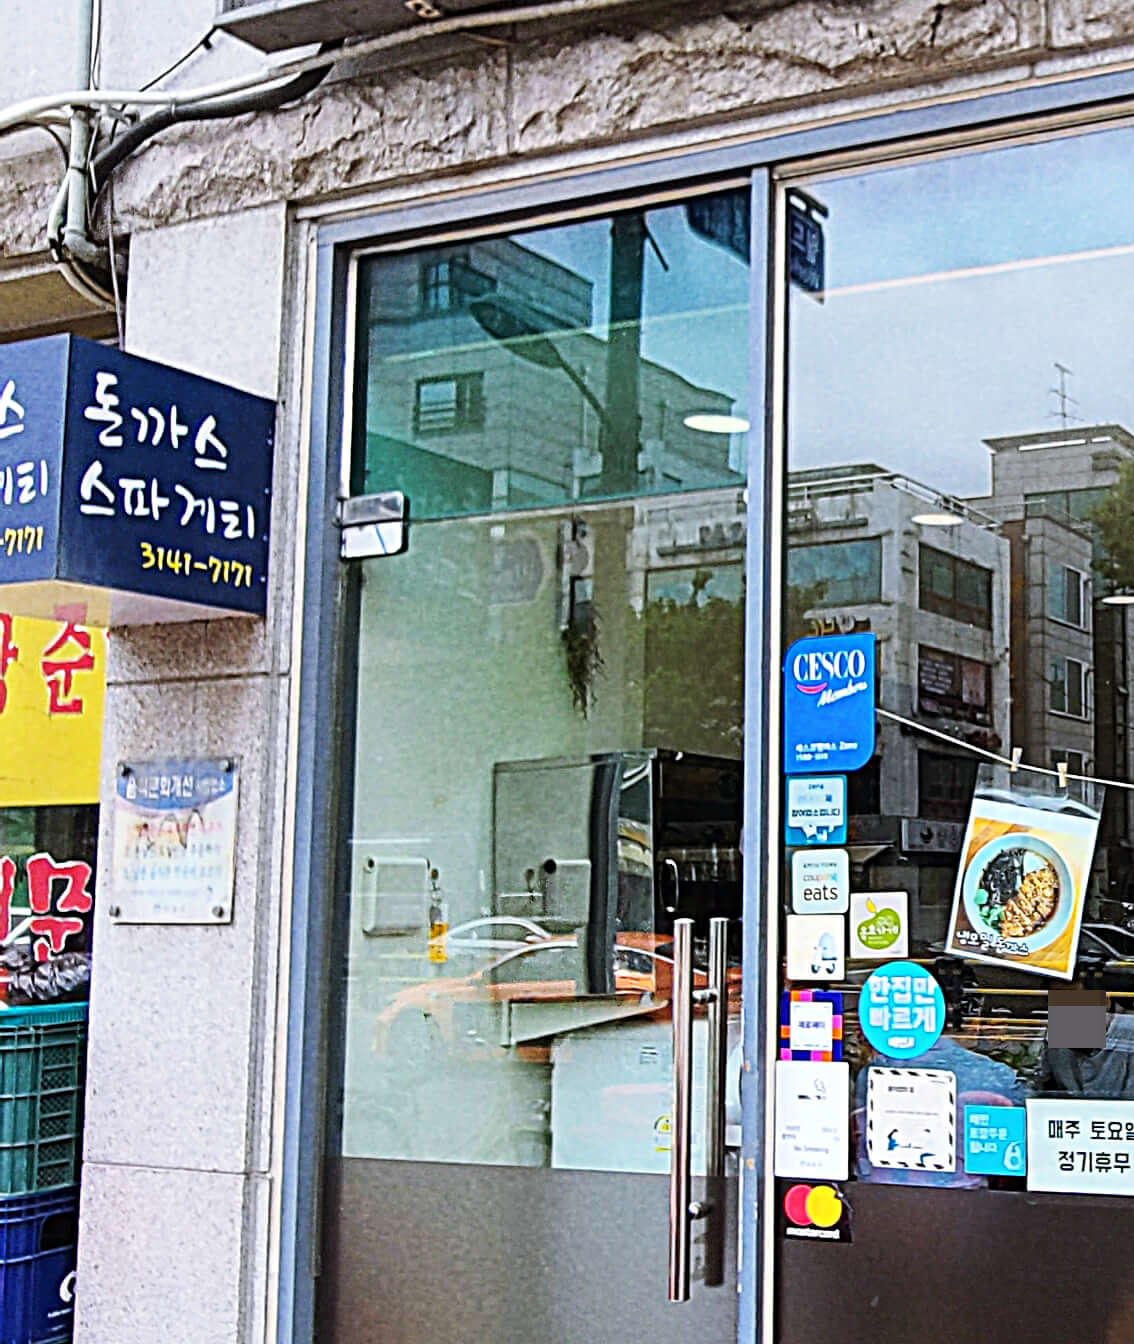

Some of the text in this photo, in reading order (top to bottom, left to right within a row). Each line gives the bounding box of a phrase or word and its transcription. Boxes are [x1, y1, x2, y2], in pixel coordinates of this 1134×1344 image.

[84, 371, 228, 471] 돈까스
[80, 460, 256, 539] 스파게티
[140, 542, 253, 588] 3141-7171
[793, 649, 866, 682] CESCO
[803, 884, 839, 902] eats
[869, 975, 939, 1005] 한집만
[869, 1005, 937, 1033] 빠르게
[1047, 1119, 1081, 1140] 매주
[1057, 1150, 1132, 1173] 정기휴무
